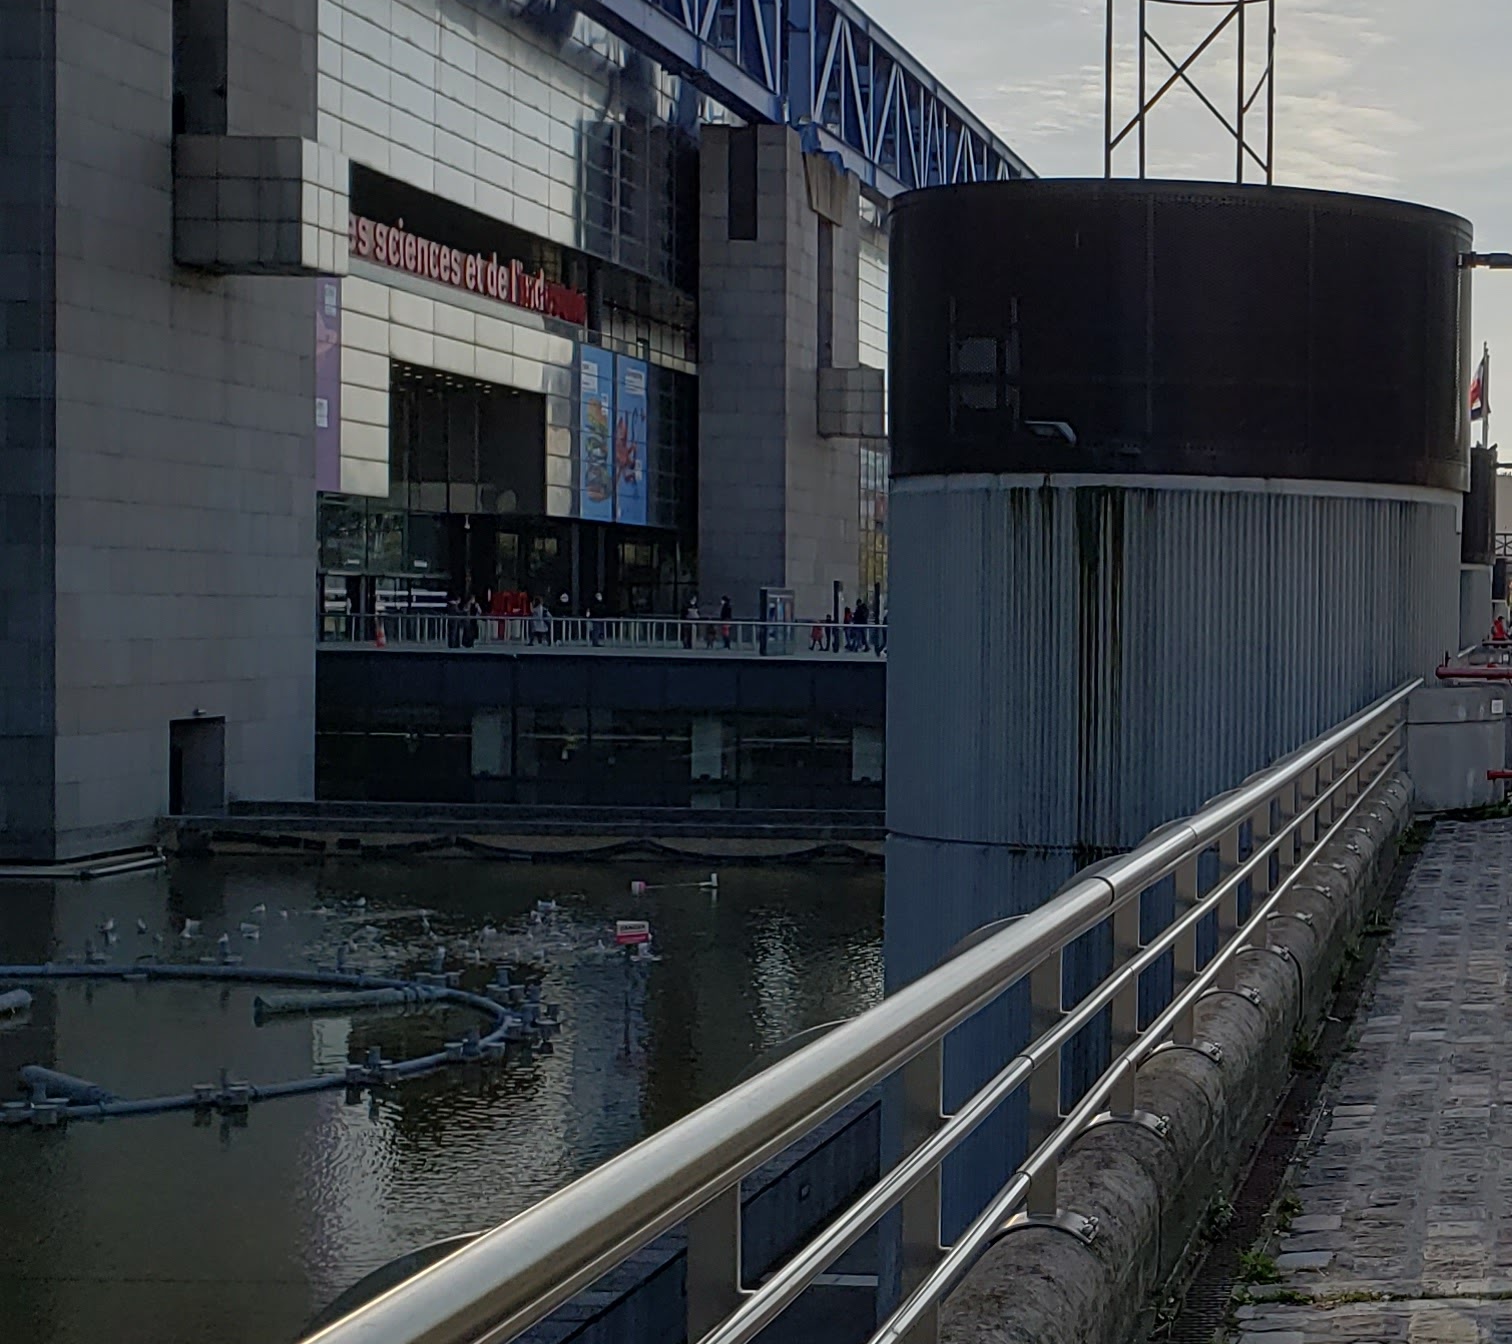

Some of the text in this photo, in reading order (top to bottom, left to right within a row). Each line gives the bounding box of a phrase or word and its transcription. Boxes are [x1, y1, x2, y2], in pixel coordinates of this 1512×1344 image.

[375, 217, 460, 284] sciences
[466, 252, 484, 293] et
[487, 252, 508, 300] de
